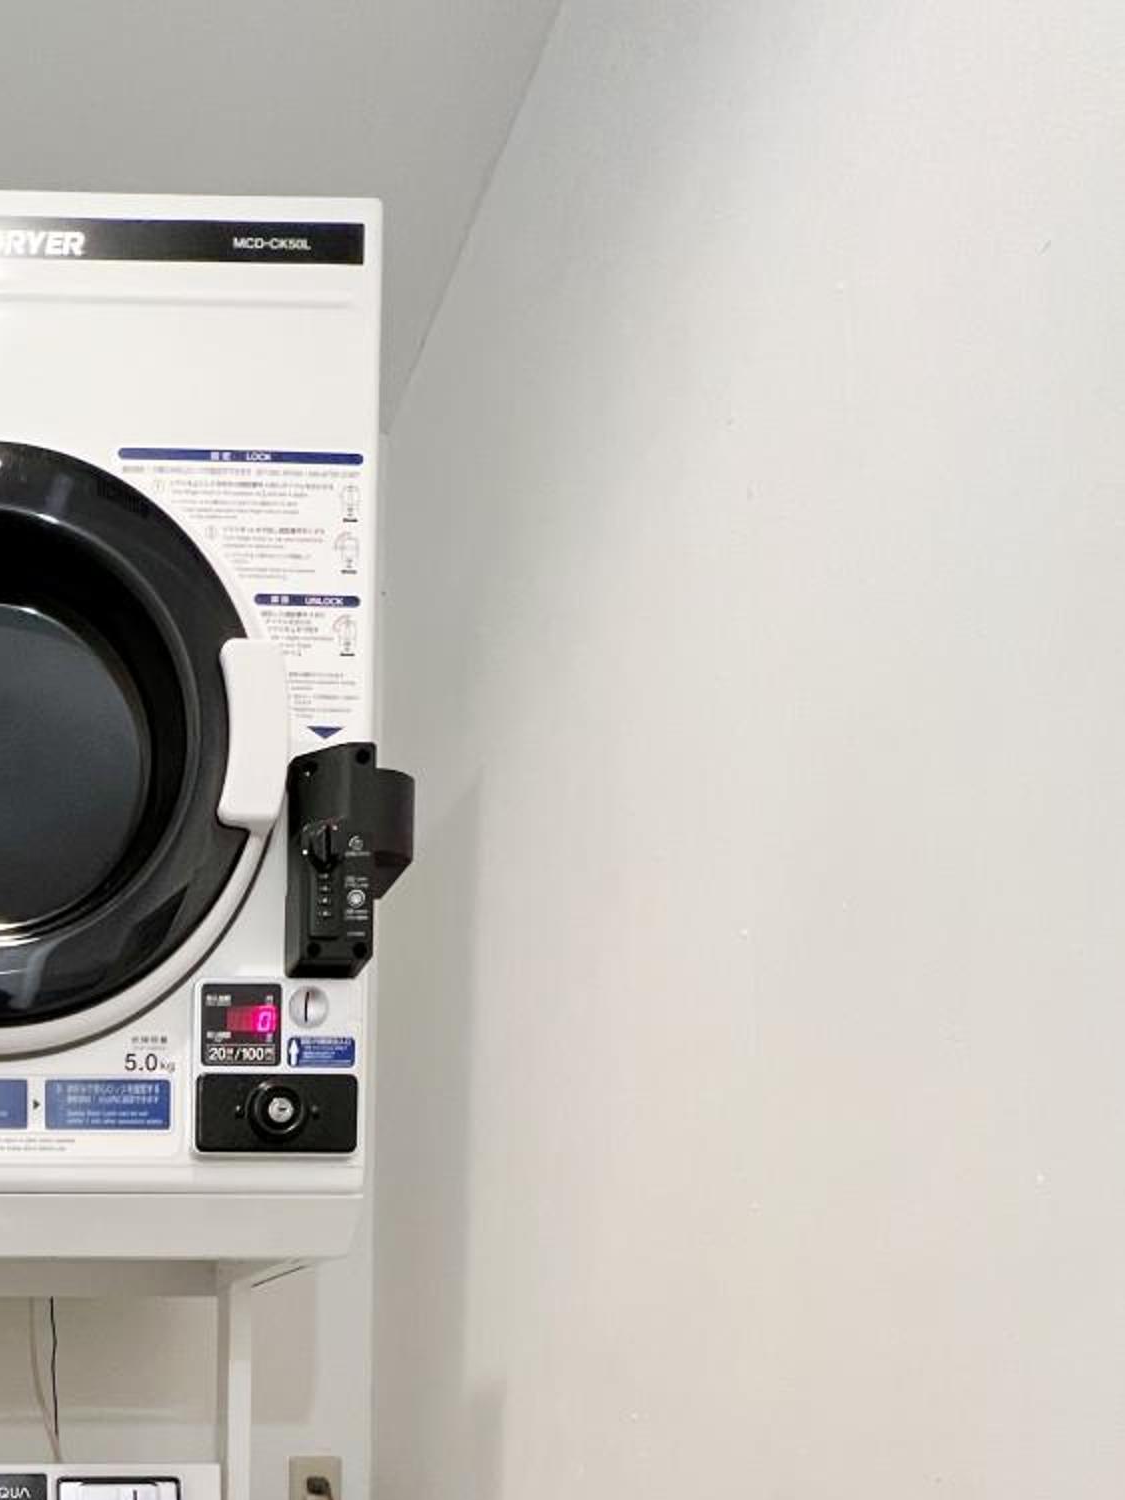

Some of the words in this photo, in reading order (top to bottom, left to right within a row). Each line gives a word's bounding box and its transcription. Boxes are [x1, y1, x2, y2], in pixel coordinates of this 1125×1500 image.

[232, 236, 312, 251] MCD-CK50L
[245, 452, 272, 461] LOCK
[257, 1010, 273, 1033] 0
